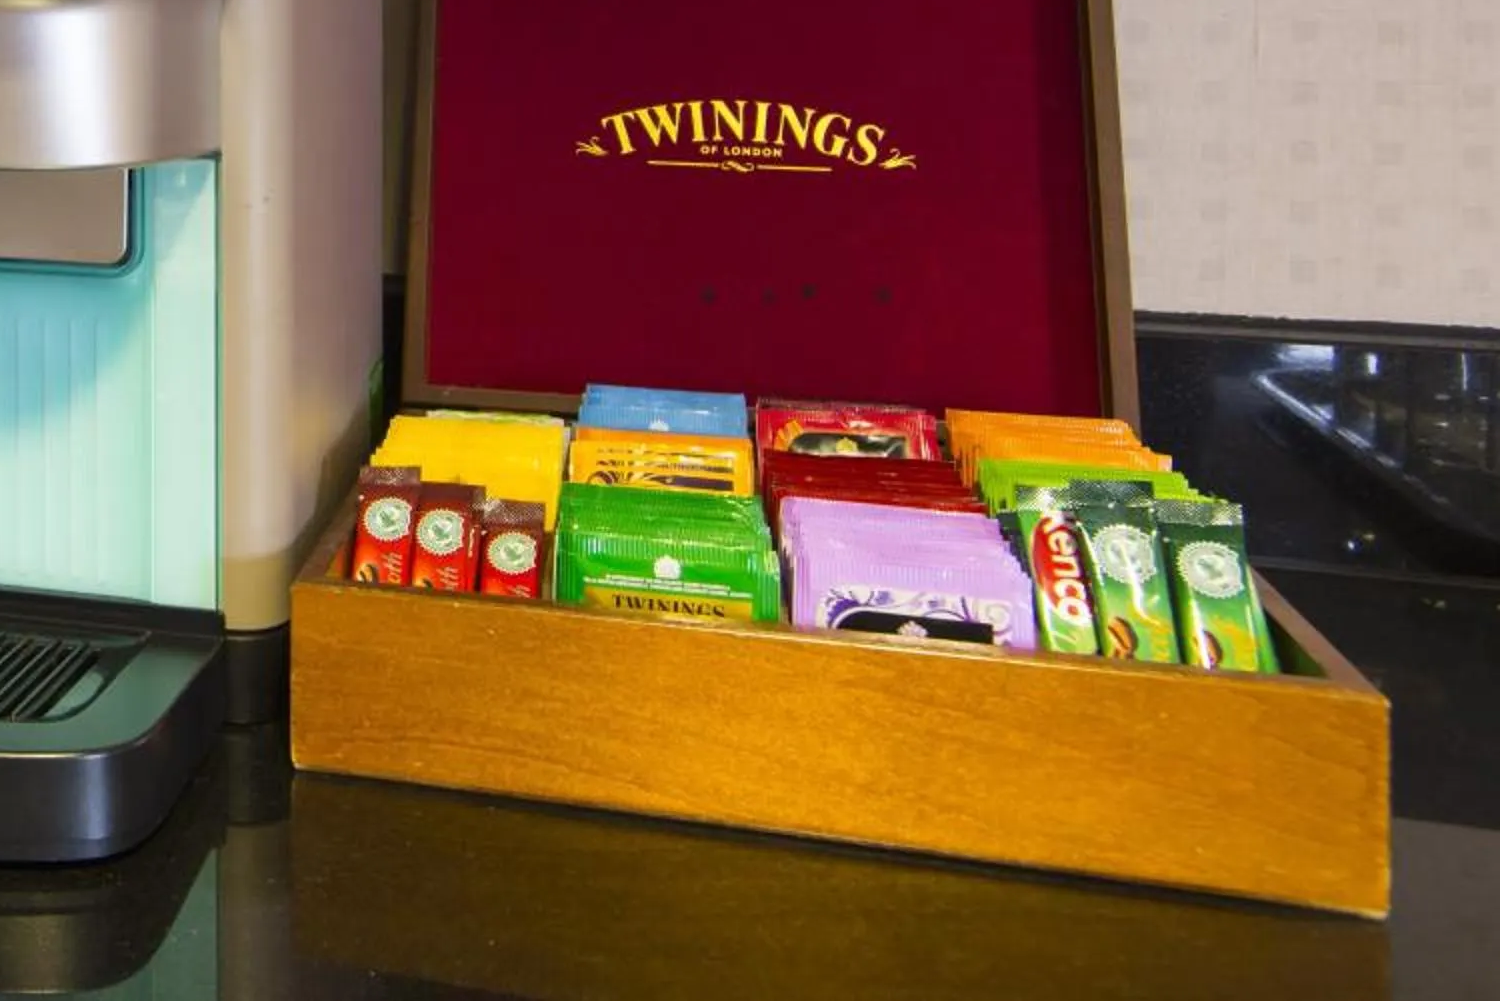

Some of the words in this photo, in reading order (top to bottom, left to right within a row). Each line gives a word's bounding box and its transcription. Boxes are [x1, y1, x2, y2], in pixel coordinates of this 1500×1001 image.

[601, 99, 886, 166] TWININGS
[700, 145, 718, 155] OF
[723, 146, 784, 158] LONDON
[1041, 508, 1093, 628] Kenco
[612, 593, 726, 619] TWININGS
